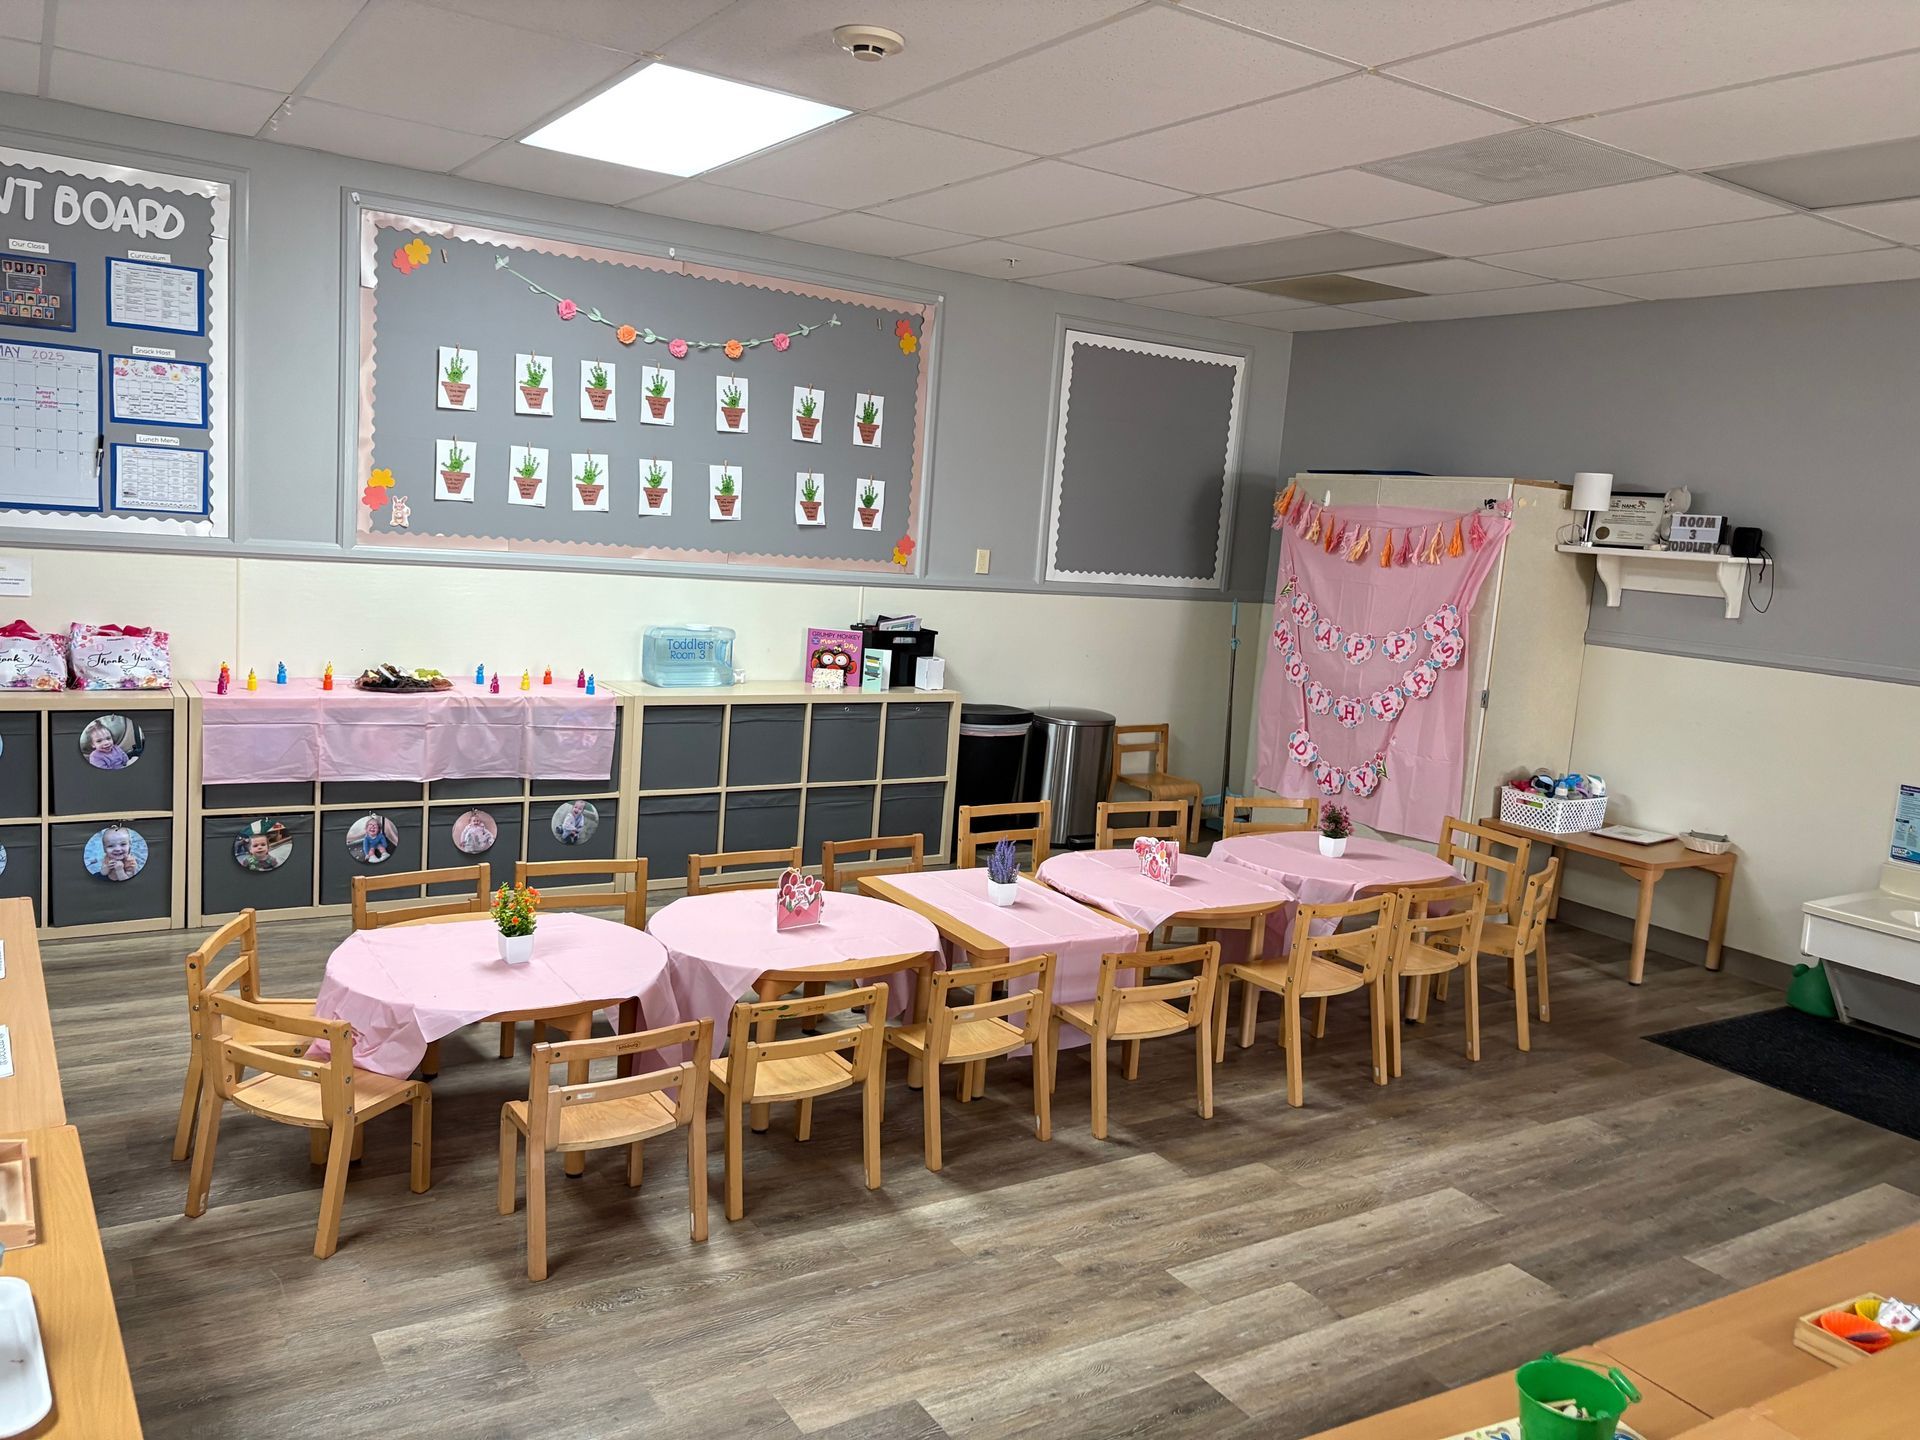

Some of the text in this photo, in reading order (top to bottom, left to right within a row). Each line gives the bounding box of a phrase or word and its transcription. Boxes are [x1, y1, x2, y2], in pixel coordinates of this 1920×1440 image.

[54, 185, 185, 240] BOARD
[11, 240, 46, 250] Our Class
[129, 252, 166, 261] Curriculum
[32, 349, 65, 361] 2025
[138, 436, 178, 445] Lunch Menu
[1679, 516, 1716, 528] ROOM
[1689, 529, 1697, 540] 3
[1298, 602, 1447, 655] HAPPY
[667, 638, 714, 650] Toddlers
[87, 651, 153, 669] Thank You
[670, 650, 706, 660] Room 3
[1277, 630, 1455, 720] MOTHERS
[1294, 739, 1369, 787] DAY
